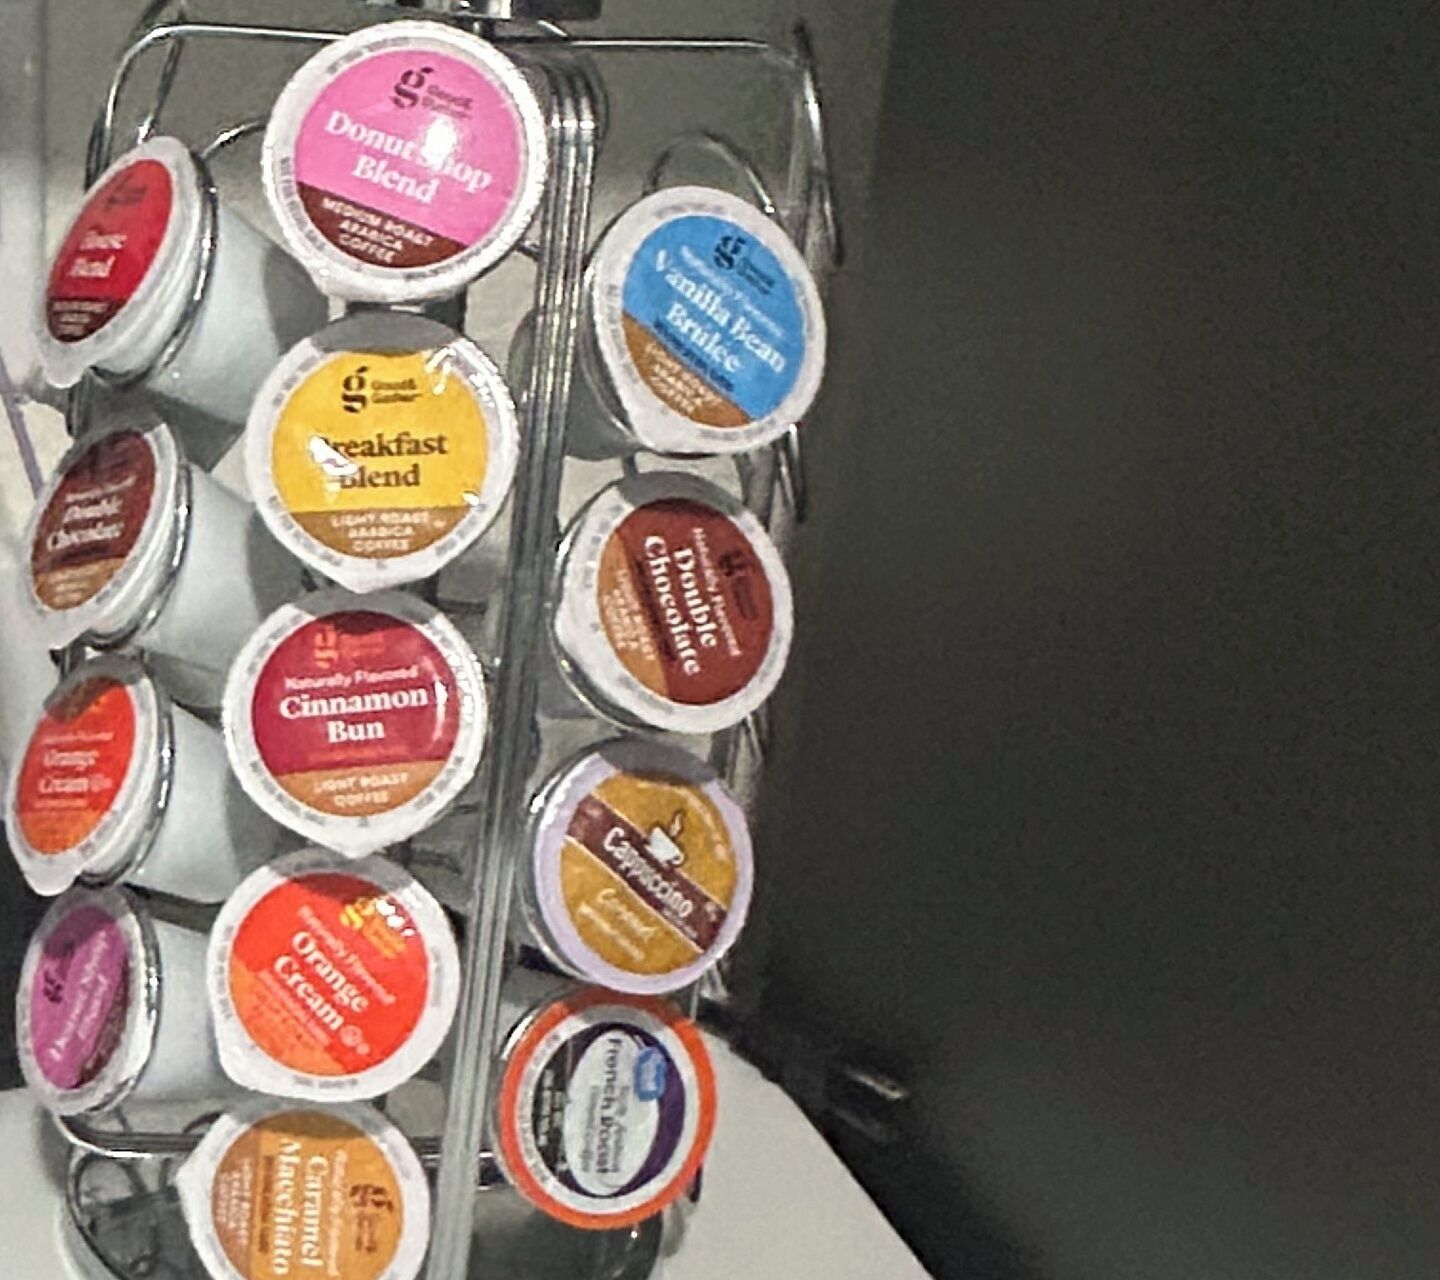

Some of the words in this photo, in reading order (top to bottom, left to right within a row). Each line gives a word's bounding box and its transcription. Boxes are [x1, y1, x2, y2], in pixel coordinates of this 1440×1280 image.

[324, 110, 417, 161] Donut
[351, 154, 440, 204] Blend
[322, 196, 383, 226] MEDIUM
[384, 219, 434, 247] ROAST
[339, 234, 396, 263] COFFEE
[340, 219, 403, 251] ARABICA
[655, 249, 731, 327] Vanilla
[729, 315, 786, 374] Bean
[313, 431, 448, 458] reakfast
[644, 535, 701, 676] Chocolate
[672, 547, 717, 647] Double
[279, 687, 429, 720] Cinnamon
[327, 721, 385, 743] Bun
[38, 777, 89, 794] Cream
[603, 826, 693, 918] Cappuccino
[273, 955, 345, 1031] Cream
[292, 931, 370, 1013] Orange
[601, 1038, 622, 1110] French
[597, 1116, 615, 1173] Roast
[273, 1138, 302, 1276] Macchiato
[301, 1155, 329, 1266] Caramel
